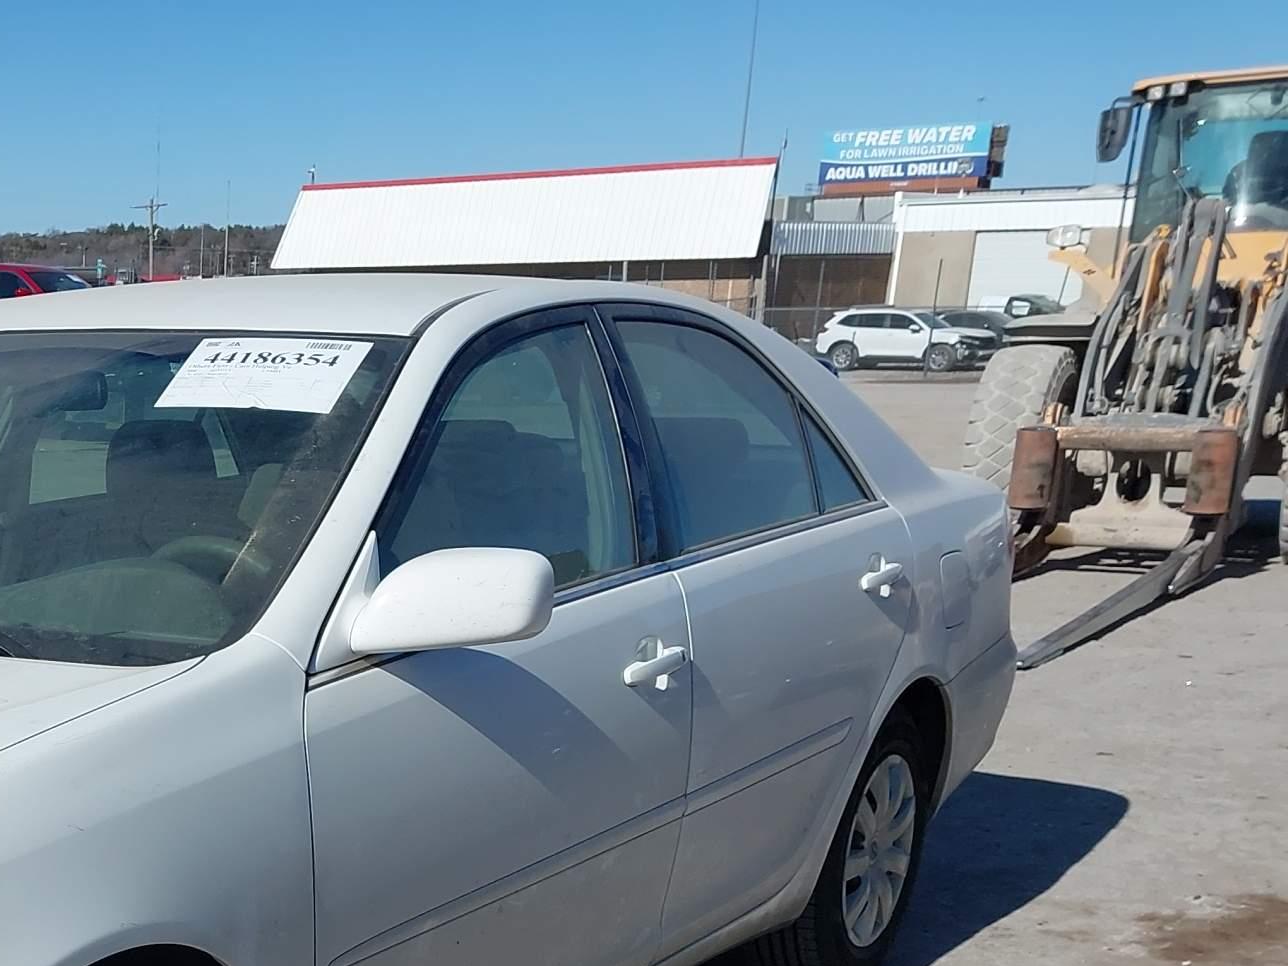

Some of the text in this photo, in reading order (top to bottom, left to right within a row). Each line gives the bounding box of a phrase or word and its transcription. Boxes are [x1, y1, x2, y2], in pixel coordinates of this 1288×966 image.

[833, 125, 976, 147] GET FREE WATER
[840, 143, 964, 160] FOR LAWN IRRIGATION
[825, 166, 865, 181] AQUA
[868, 164, 905, 179] WELL
[203, 351, 341, 368] 44186354
